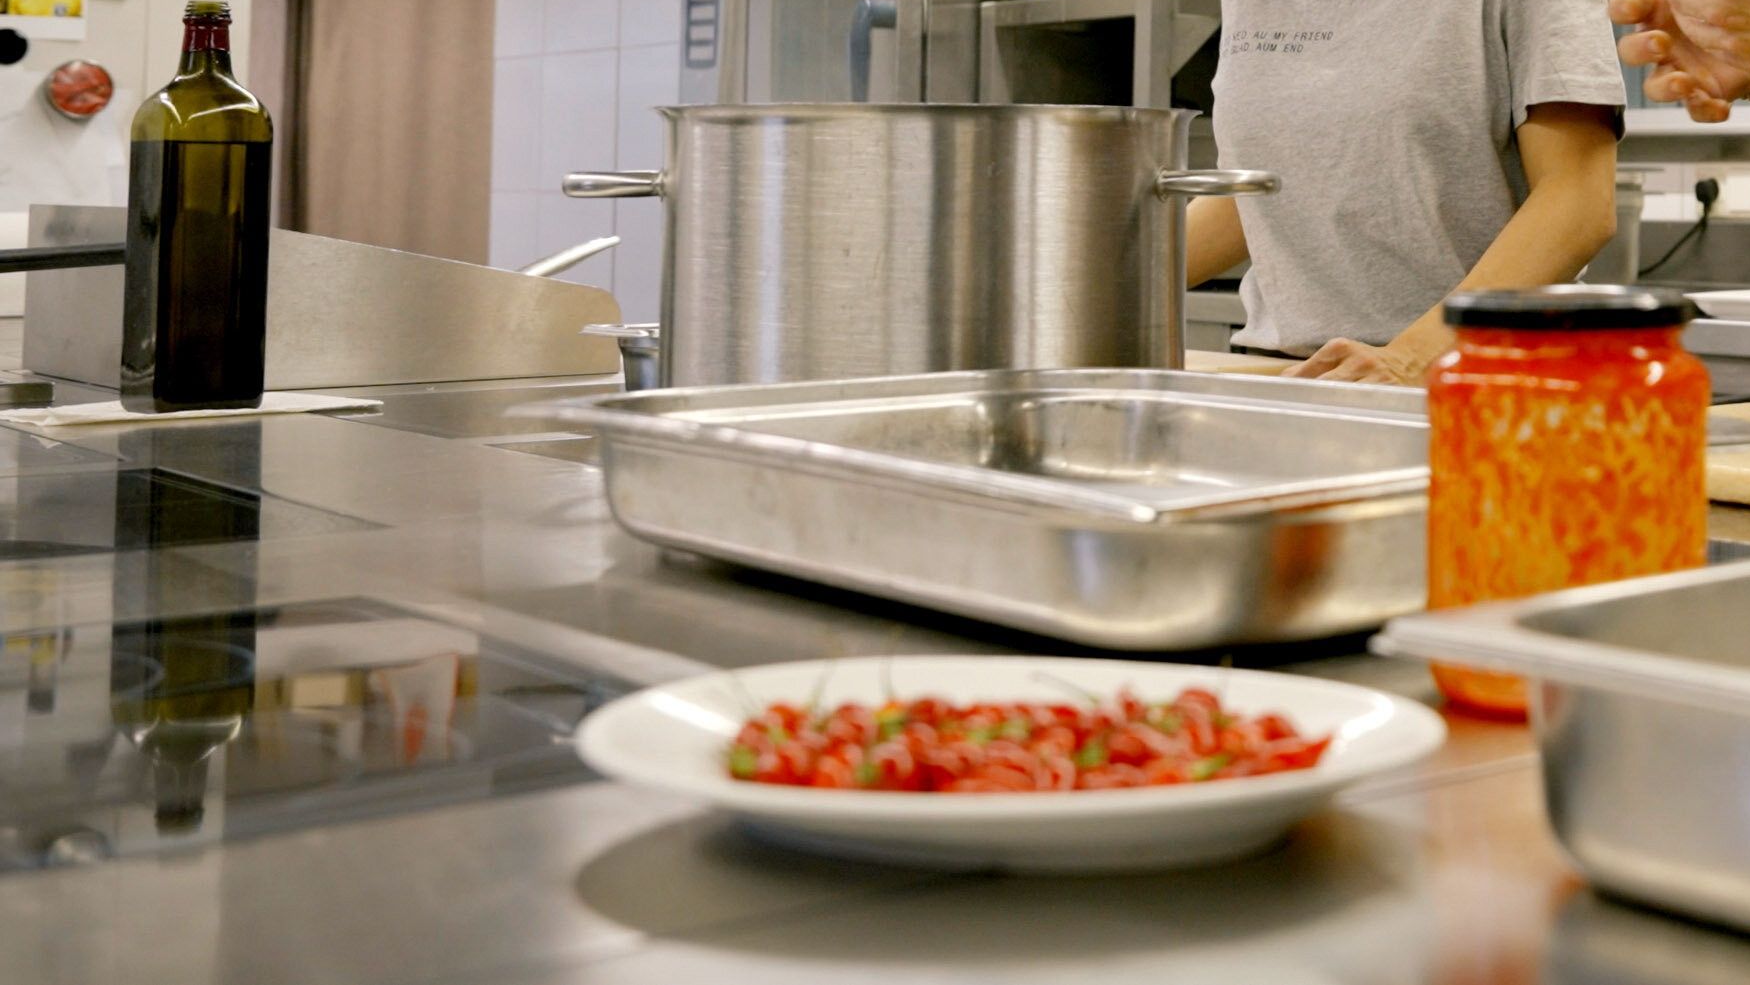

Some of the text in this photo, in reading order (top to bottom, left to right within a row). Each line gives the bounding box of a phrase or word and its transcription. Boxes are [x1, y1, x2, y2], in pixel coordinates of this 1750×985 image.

[1273, 31, 1288, 41] MY
[1293, 31, 1334, 41] FRIEND
[1283, 43, 1304, 54] END
